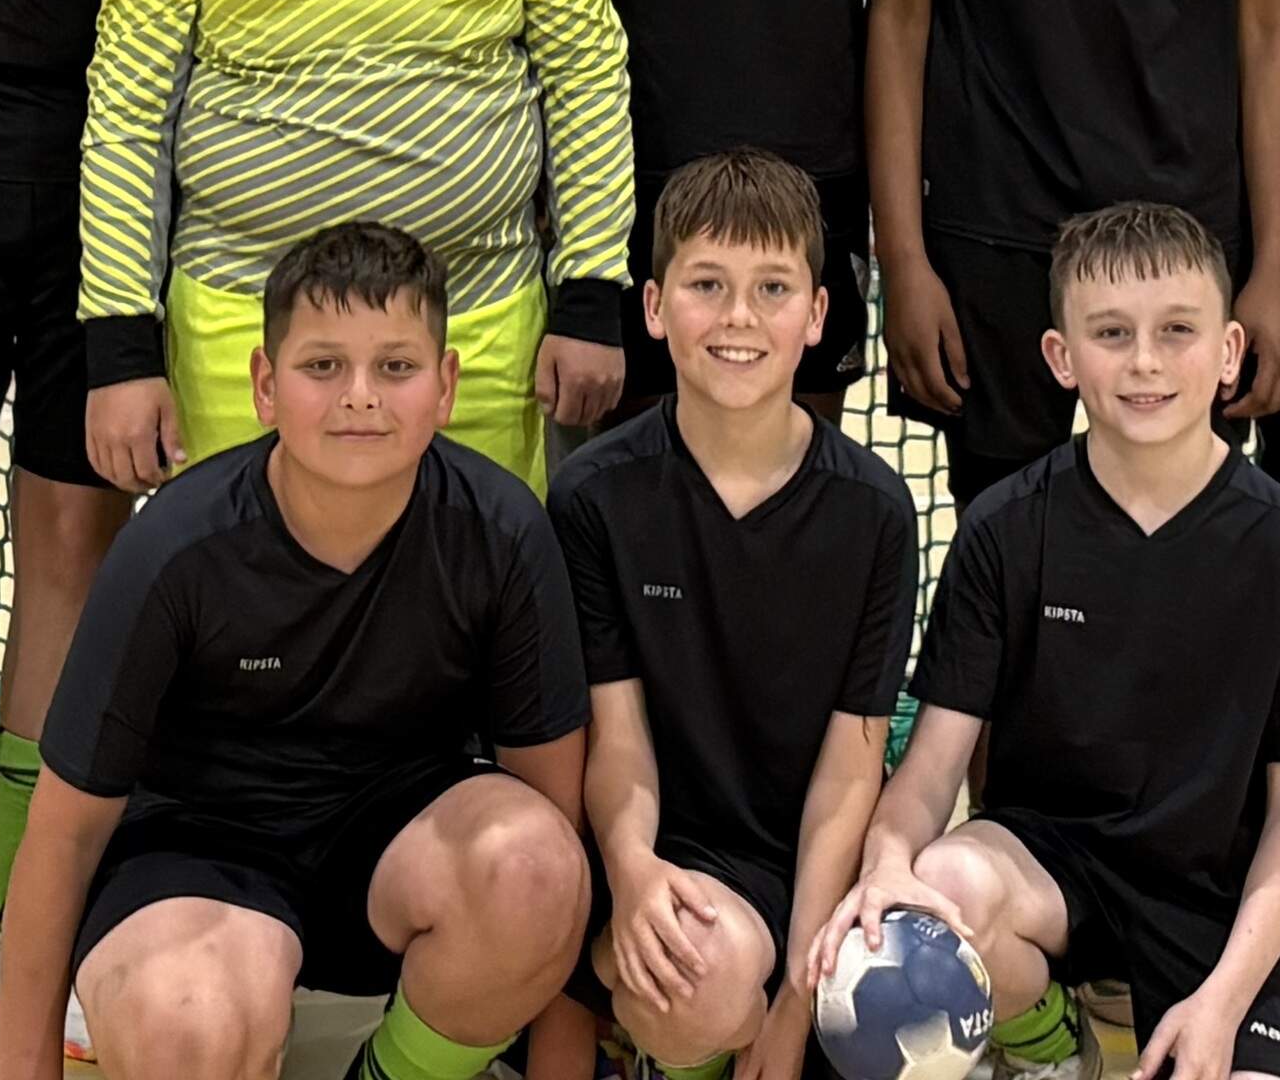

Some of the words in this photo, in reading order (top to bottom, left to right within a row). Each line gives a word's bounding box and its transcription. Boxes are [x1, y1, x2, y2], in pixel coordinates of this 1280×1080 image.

[643, 584, 683, 599] KIPSTA
[1044, 605, 1085, 623] KIPSTA
[239, 657, 281, 671] KIPSTA
